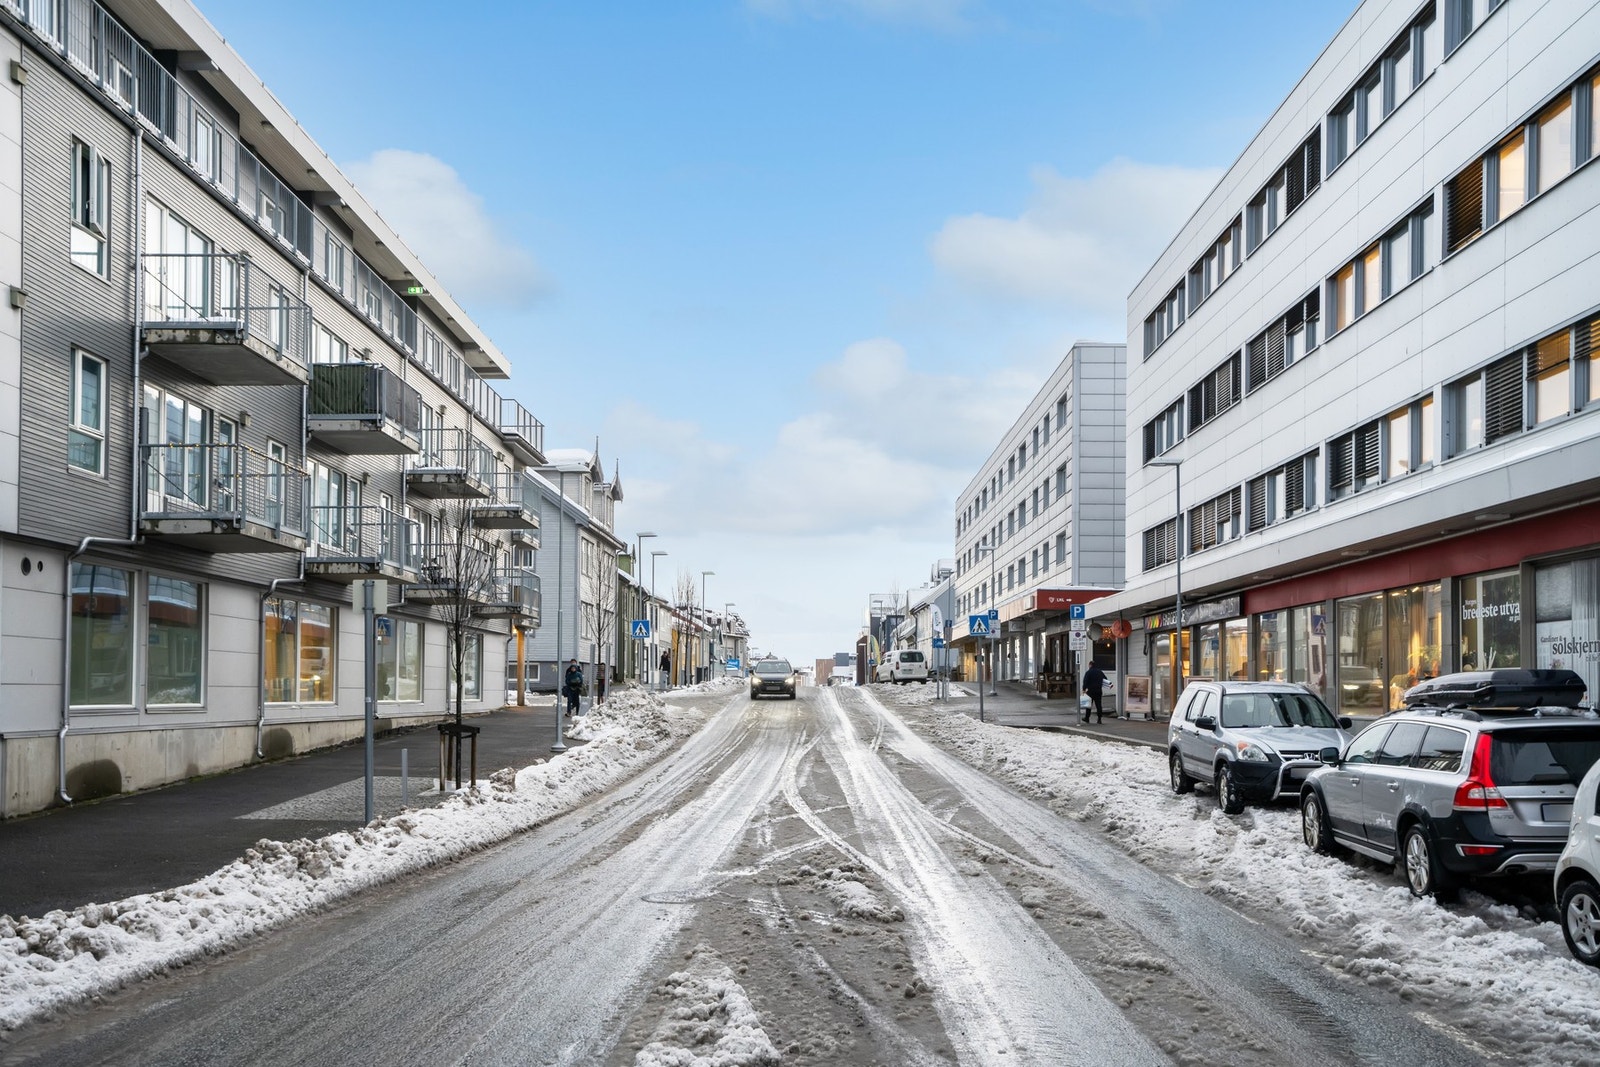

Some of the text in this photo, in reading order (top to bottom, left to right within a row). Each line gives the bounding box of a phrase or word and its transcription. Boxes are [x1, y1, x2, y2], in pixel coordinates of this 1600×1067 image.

[990, 611, 997, 619] P
[1073, 606, 1082, 617] P
[1462, 603, 1498, 620] bredeste
